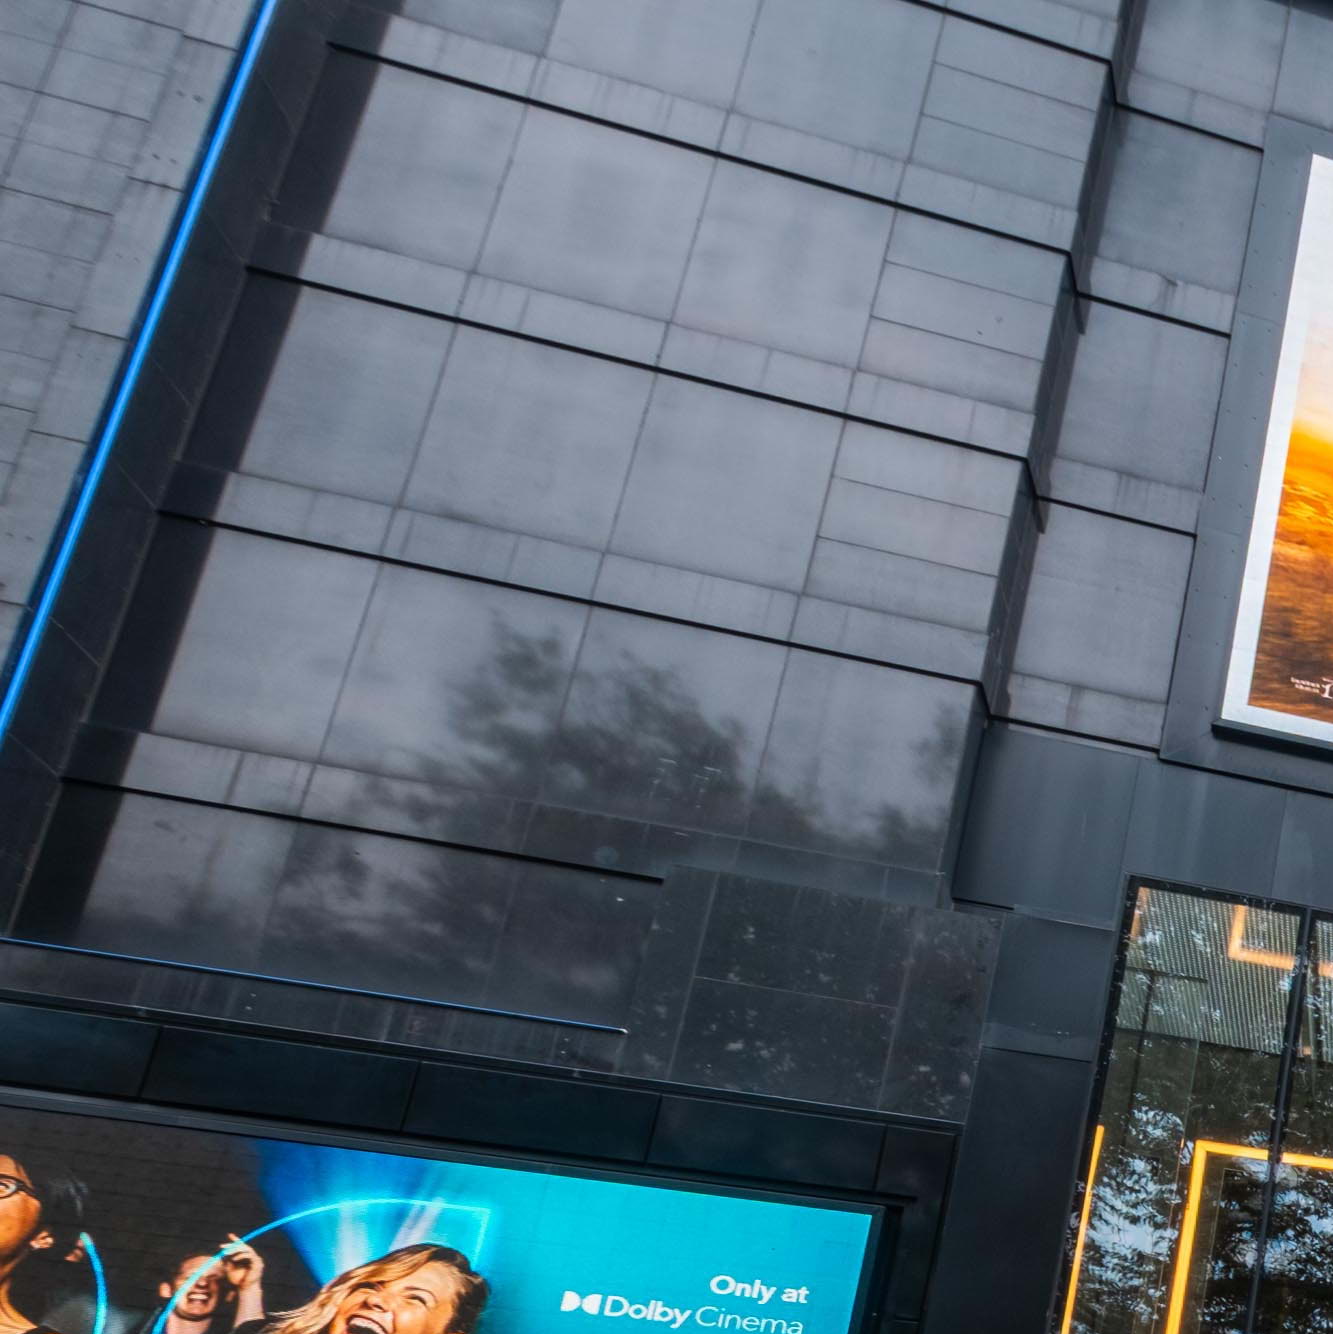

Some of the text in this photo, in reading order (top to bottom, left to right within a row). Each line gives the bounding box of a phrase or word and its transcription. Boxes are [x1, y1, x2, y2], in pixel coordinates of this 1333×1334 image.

[709, 1275, 809, 1305] Only at
[604, 1295, 692, 1329] Dolby
